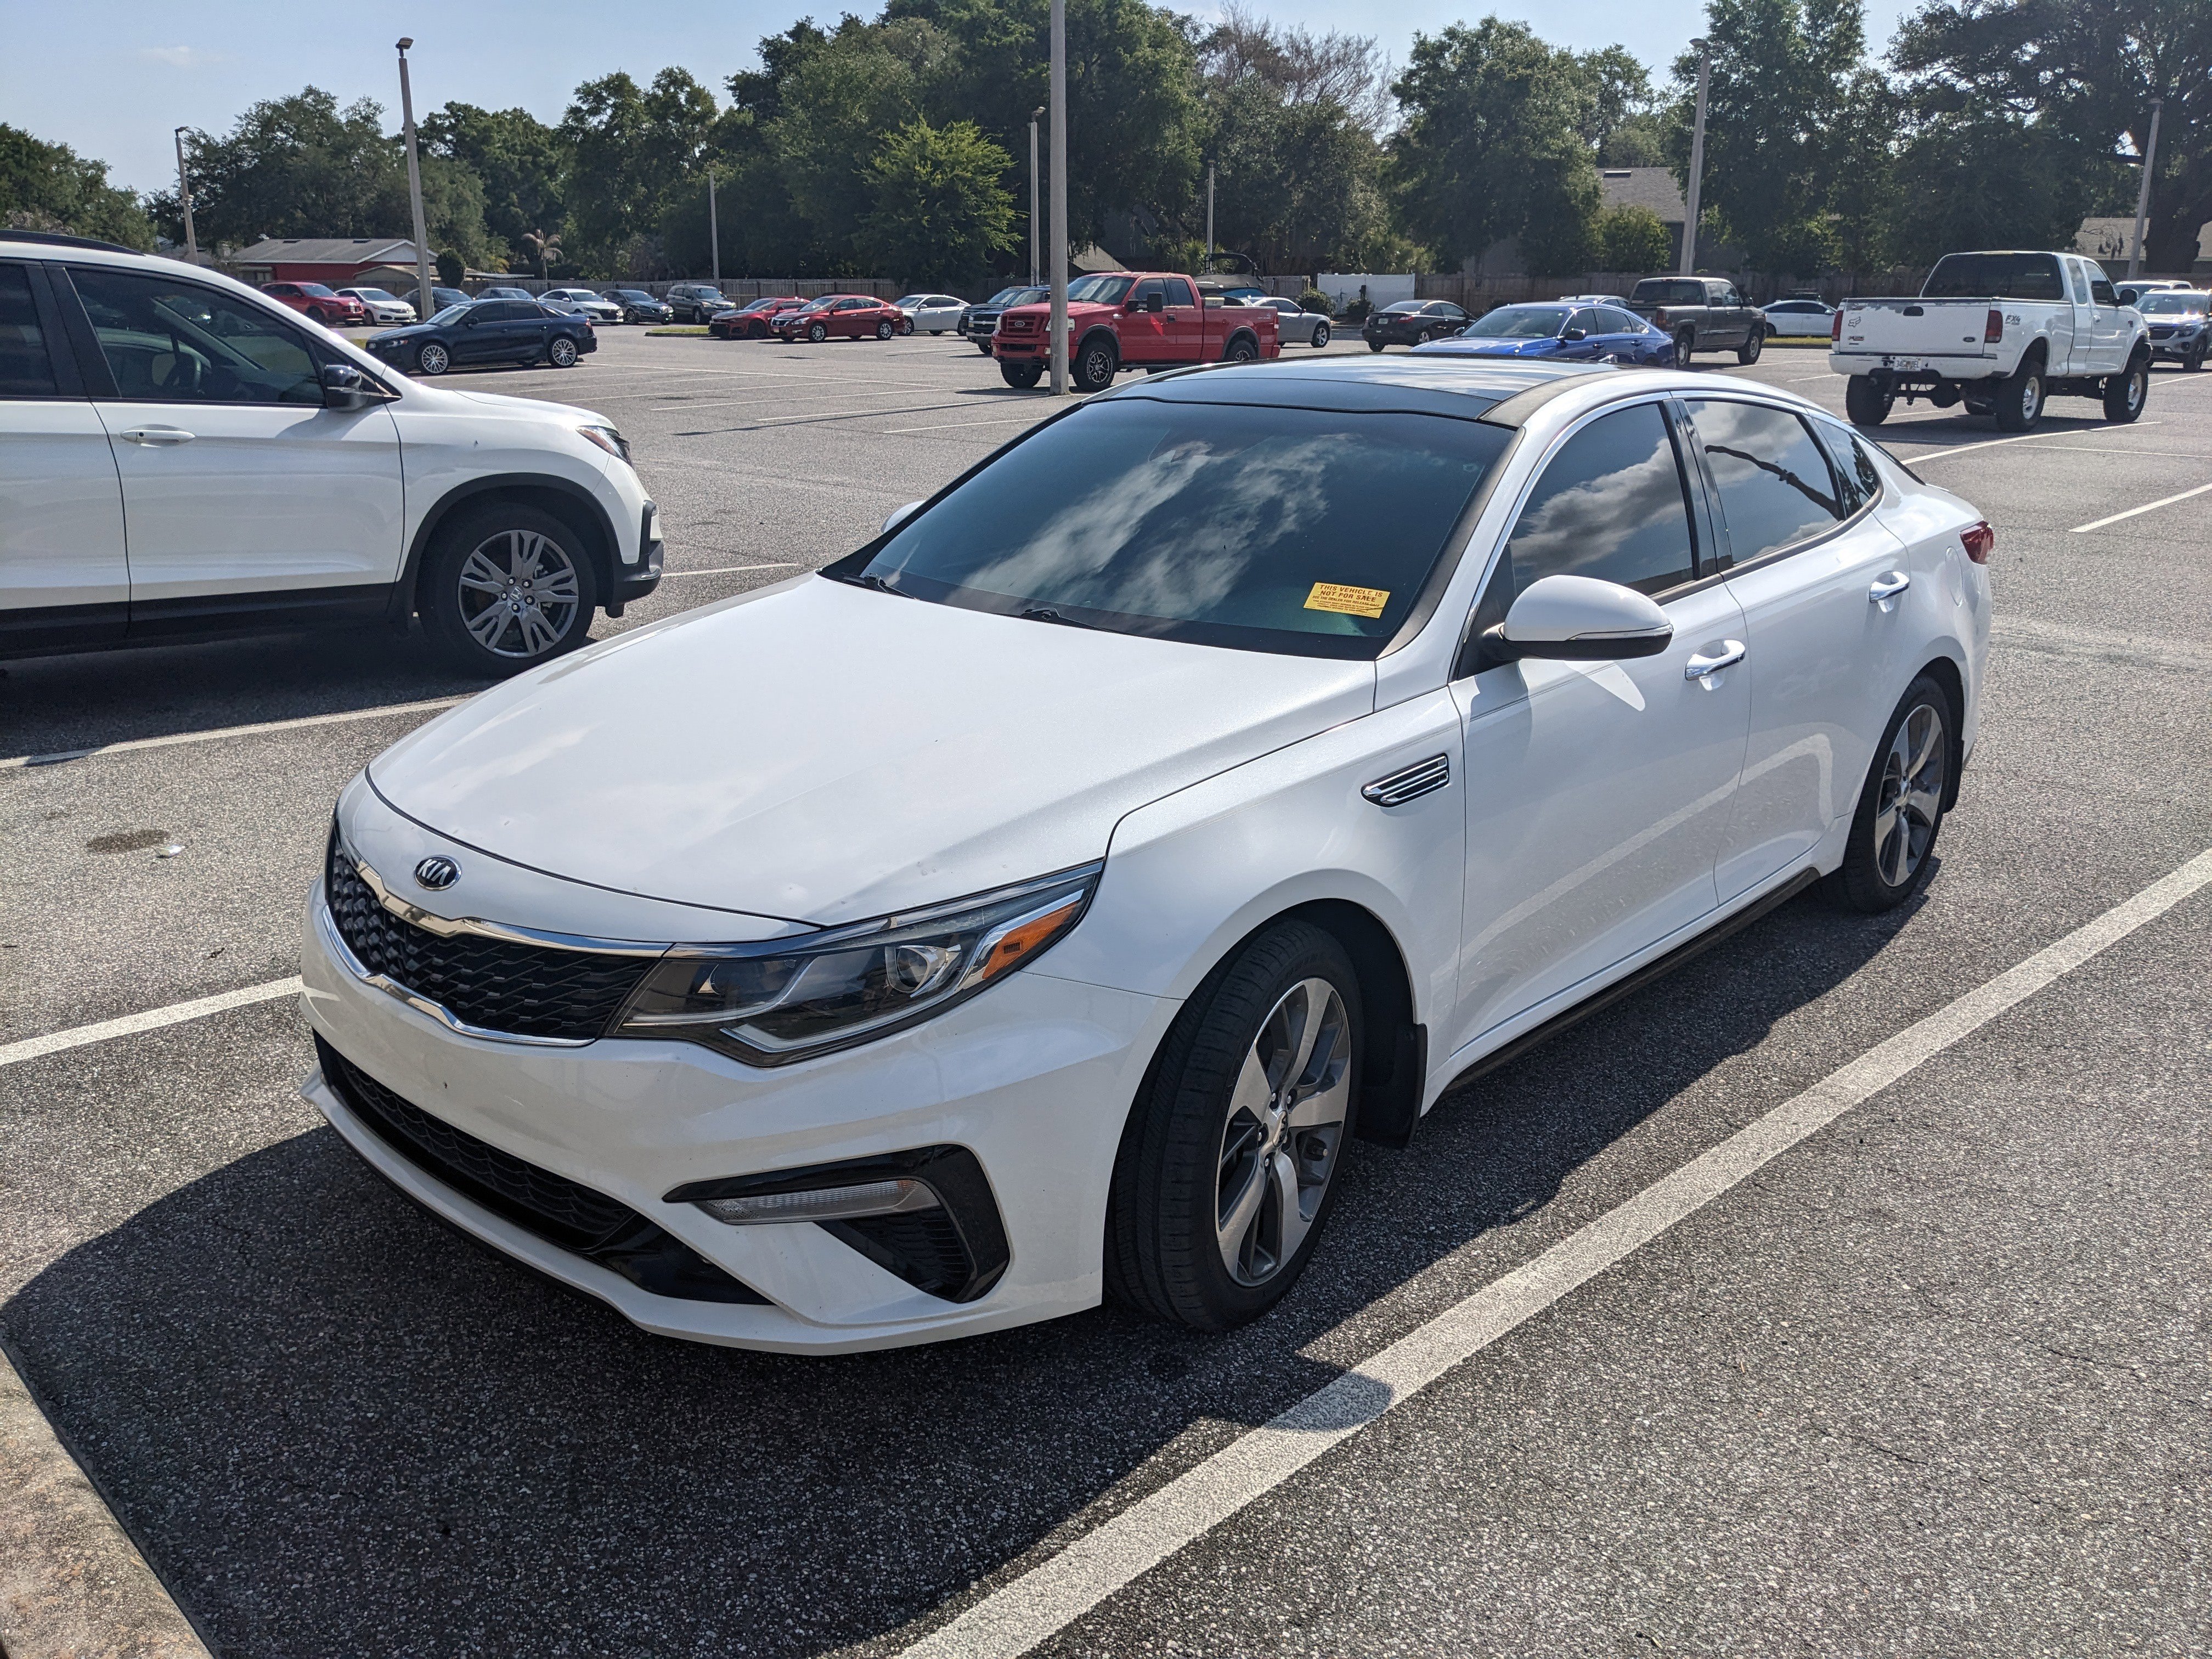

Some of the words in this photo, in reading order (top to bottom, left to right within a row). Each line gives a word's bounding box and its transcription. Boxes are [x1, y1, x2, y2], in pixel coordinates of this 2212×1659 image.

[2005, 314, 2021, 323] FX4
[1340, 586, 1373, 595] VEHICLE
[417, 859, 452, 885] KIA
